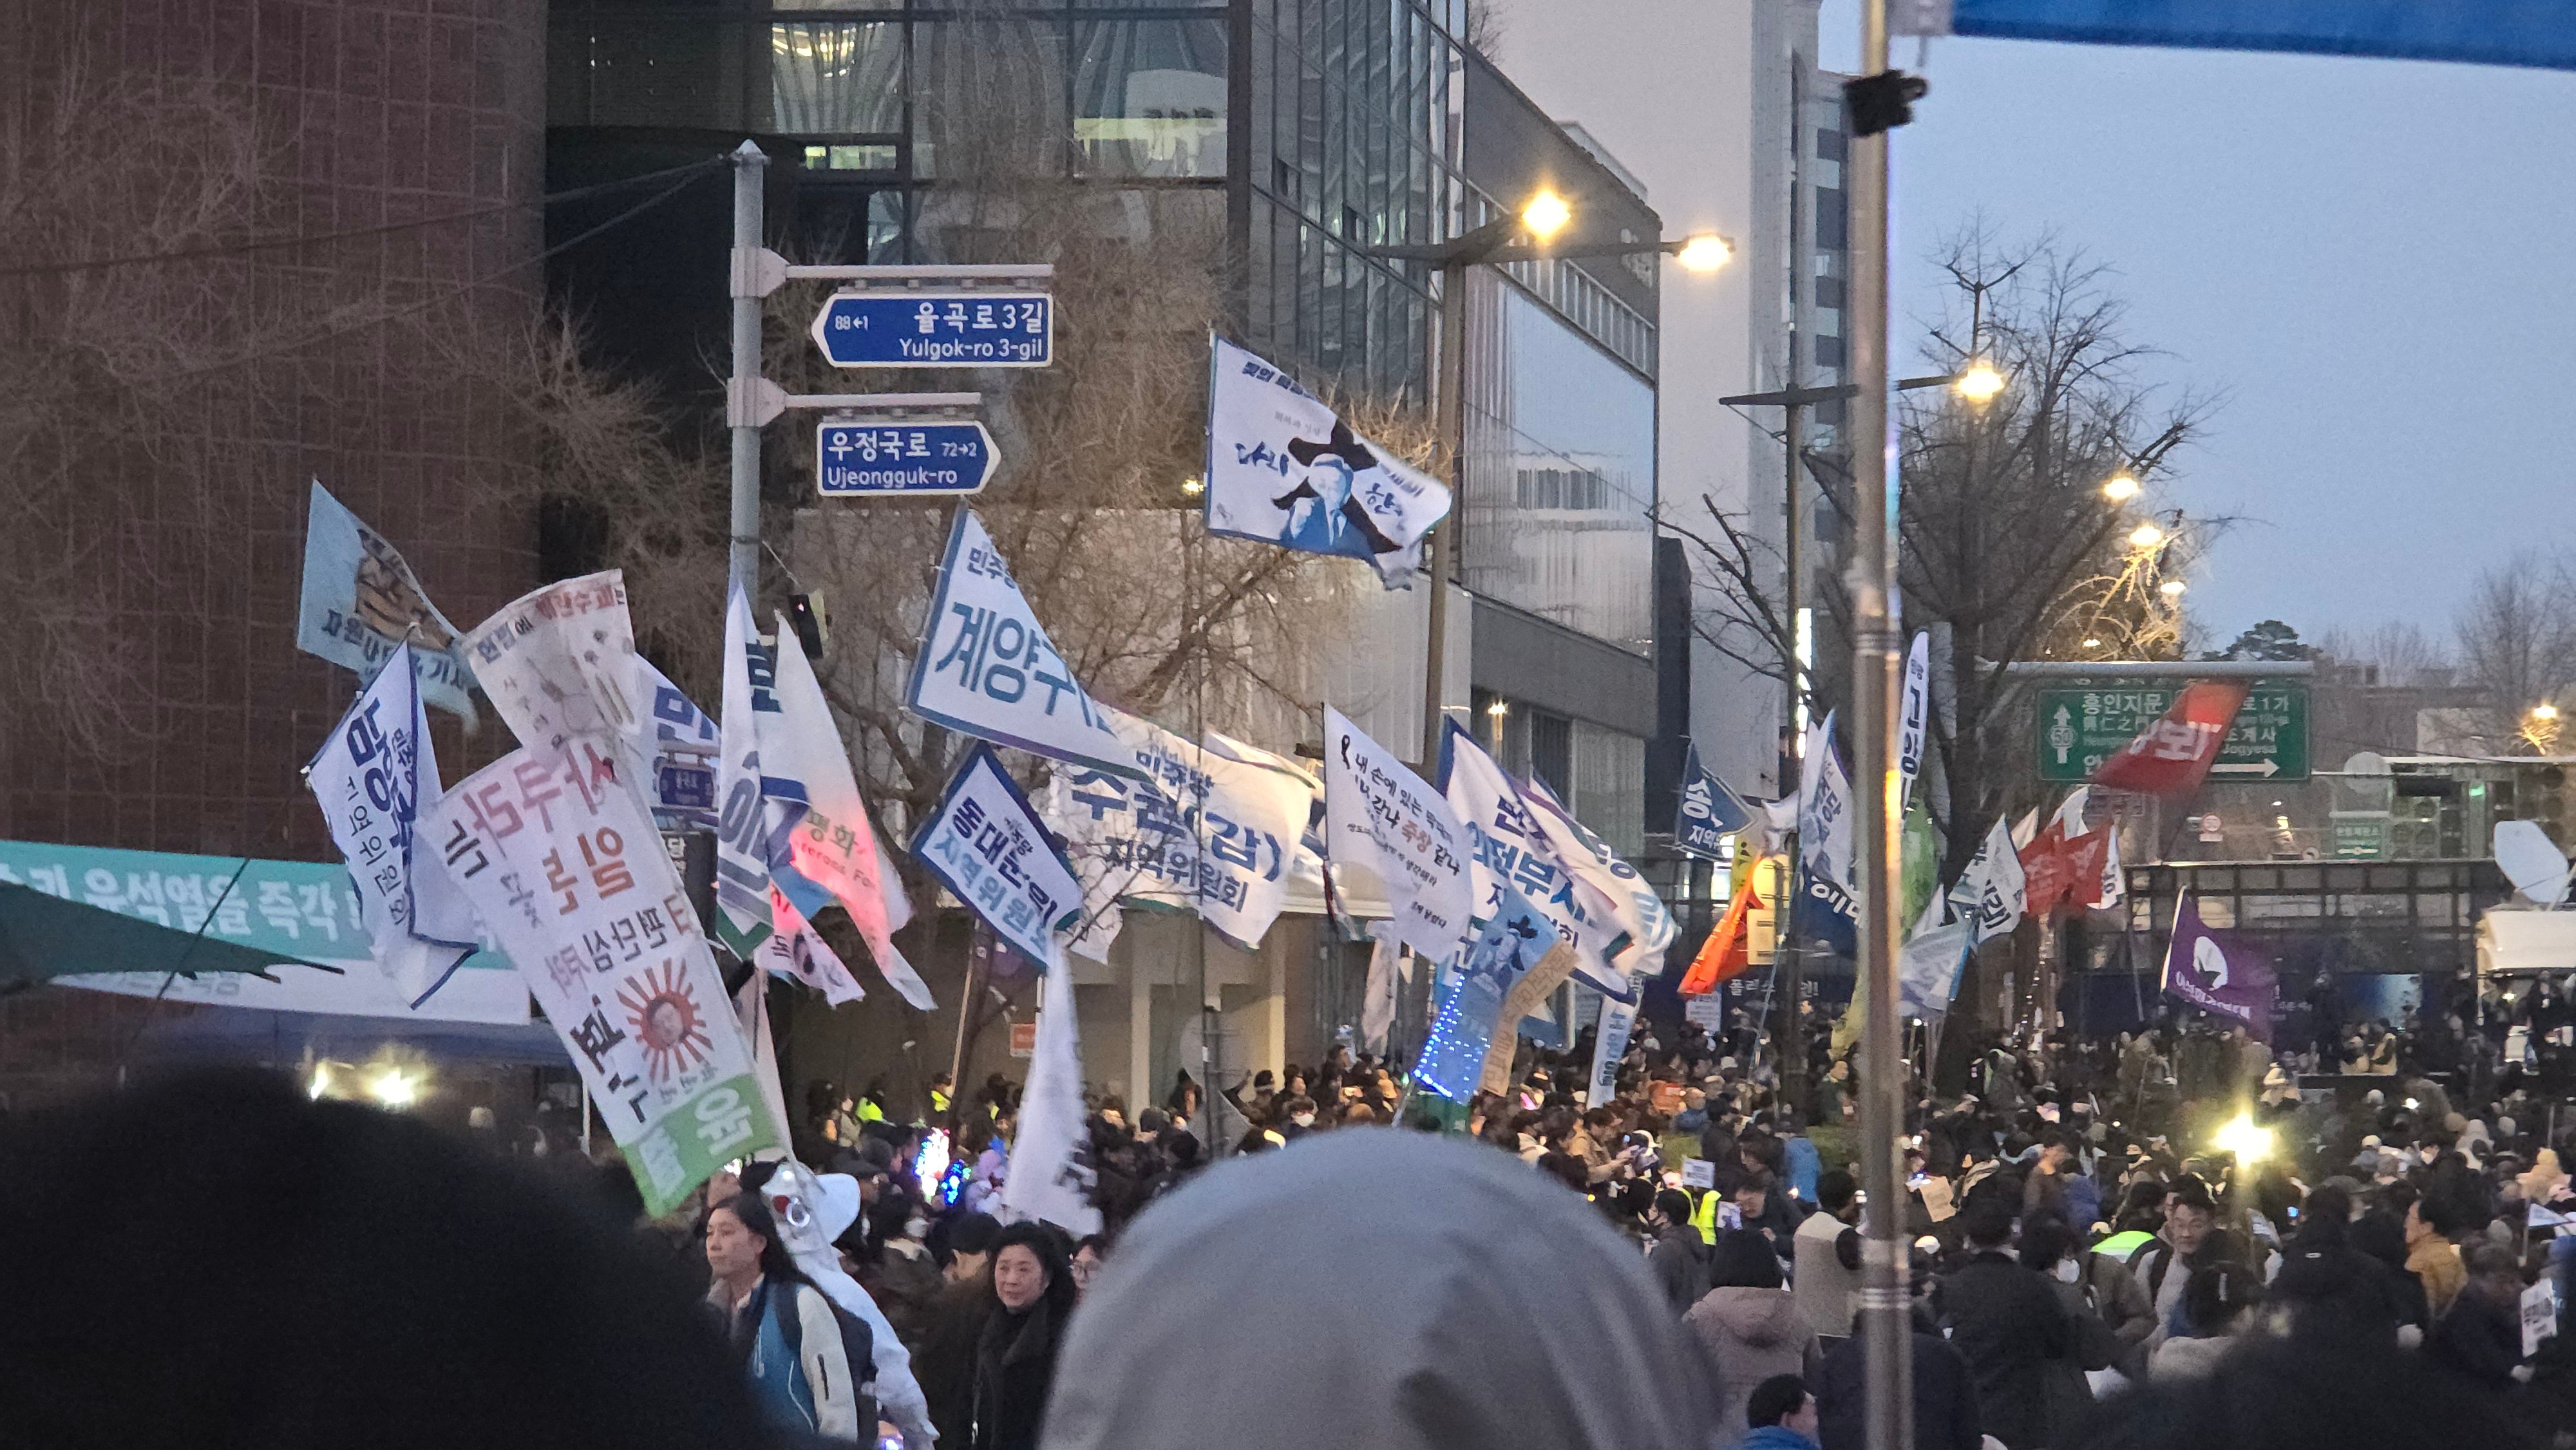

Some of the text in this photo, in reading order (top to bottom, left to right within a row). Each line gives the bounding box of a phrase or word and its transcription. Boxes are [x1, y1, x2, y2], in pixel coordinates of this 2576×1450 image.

[914, 302, 1043, 334] 율곡로3길
[899, 338, 1043, 361] Yulgok-ro 3-gil
[828, 431, 931, 462] 우정국로
[828, 466, 958, 489] Ujeongguk-ro
[2081, 693, 2164, 715] 흥인지문
[2240, 694, 2290, 713] 로1가
[1370, 766, 1397, 798] 손에
[1399, 789, 1423, 818] 있는
[257, 880, 339, 943] 즉각
